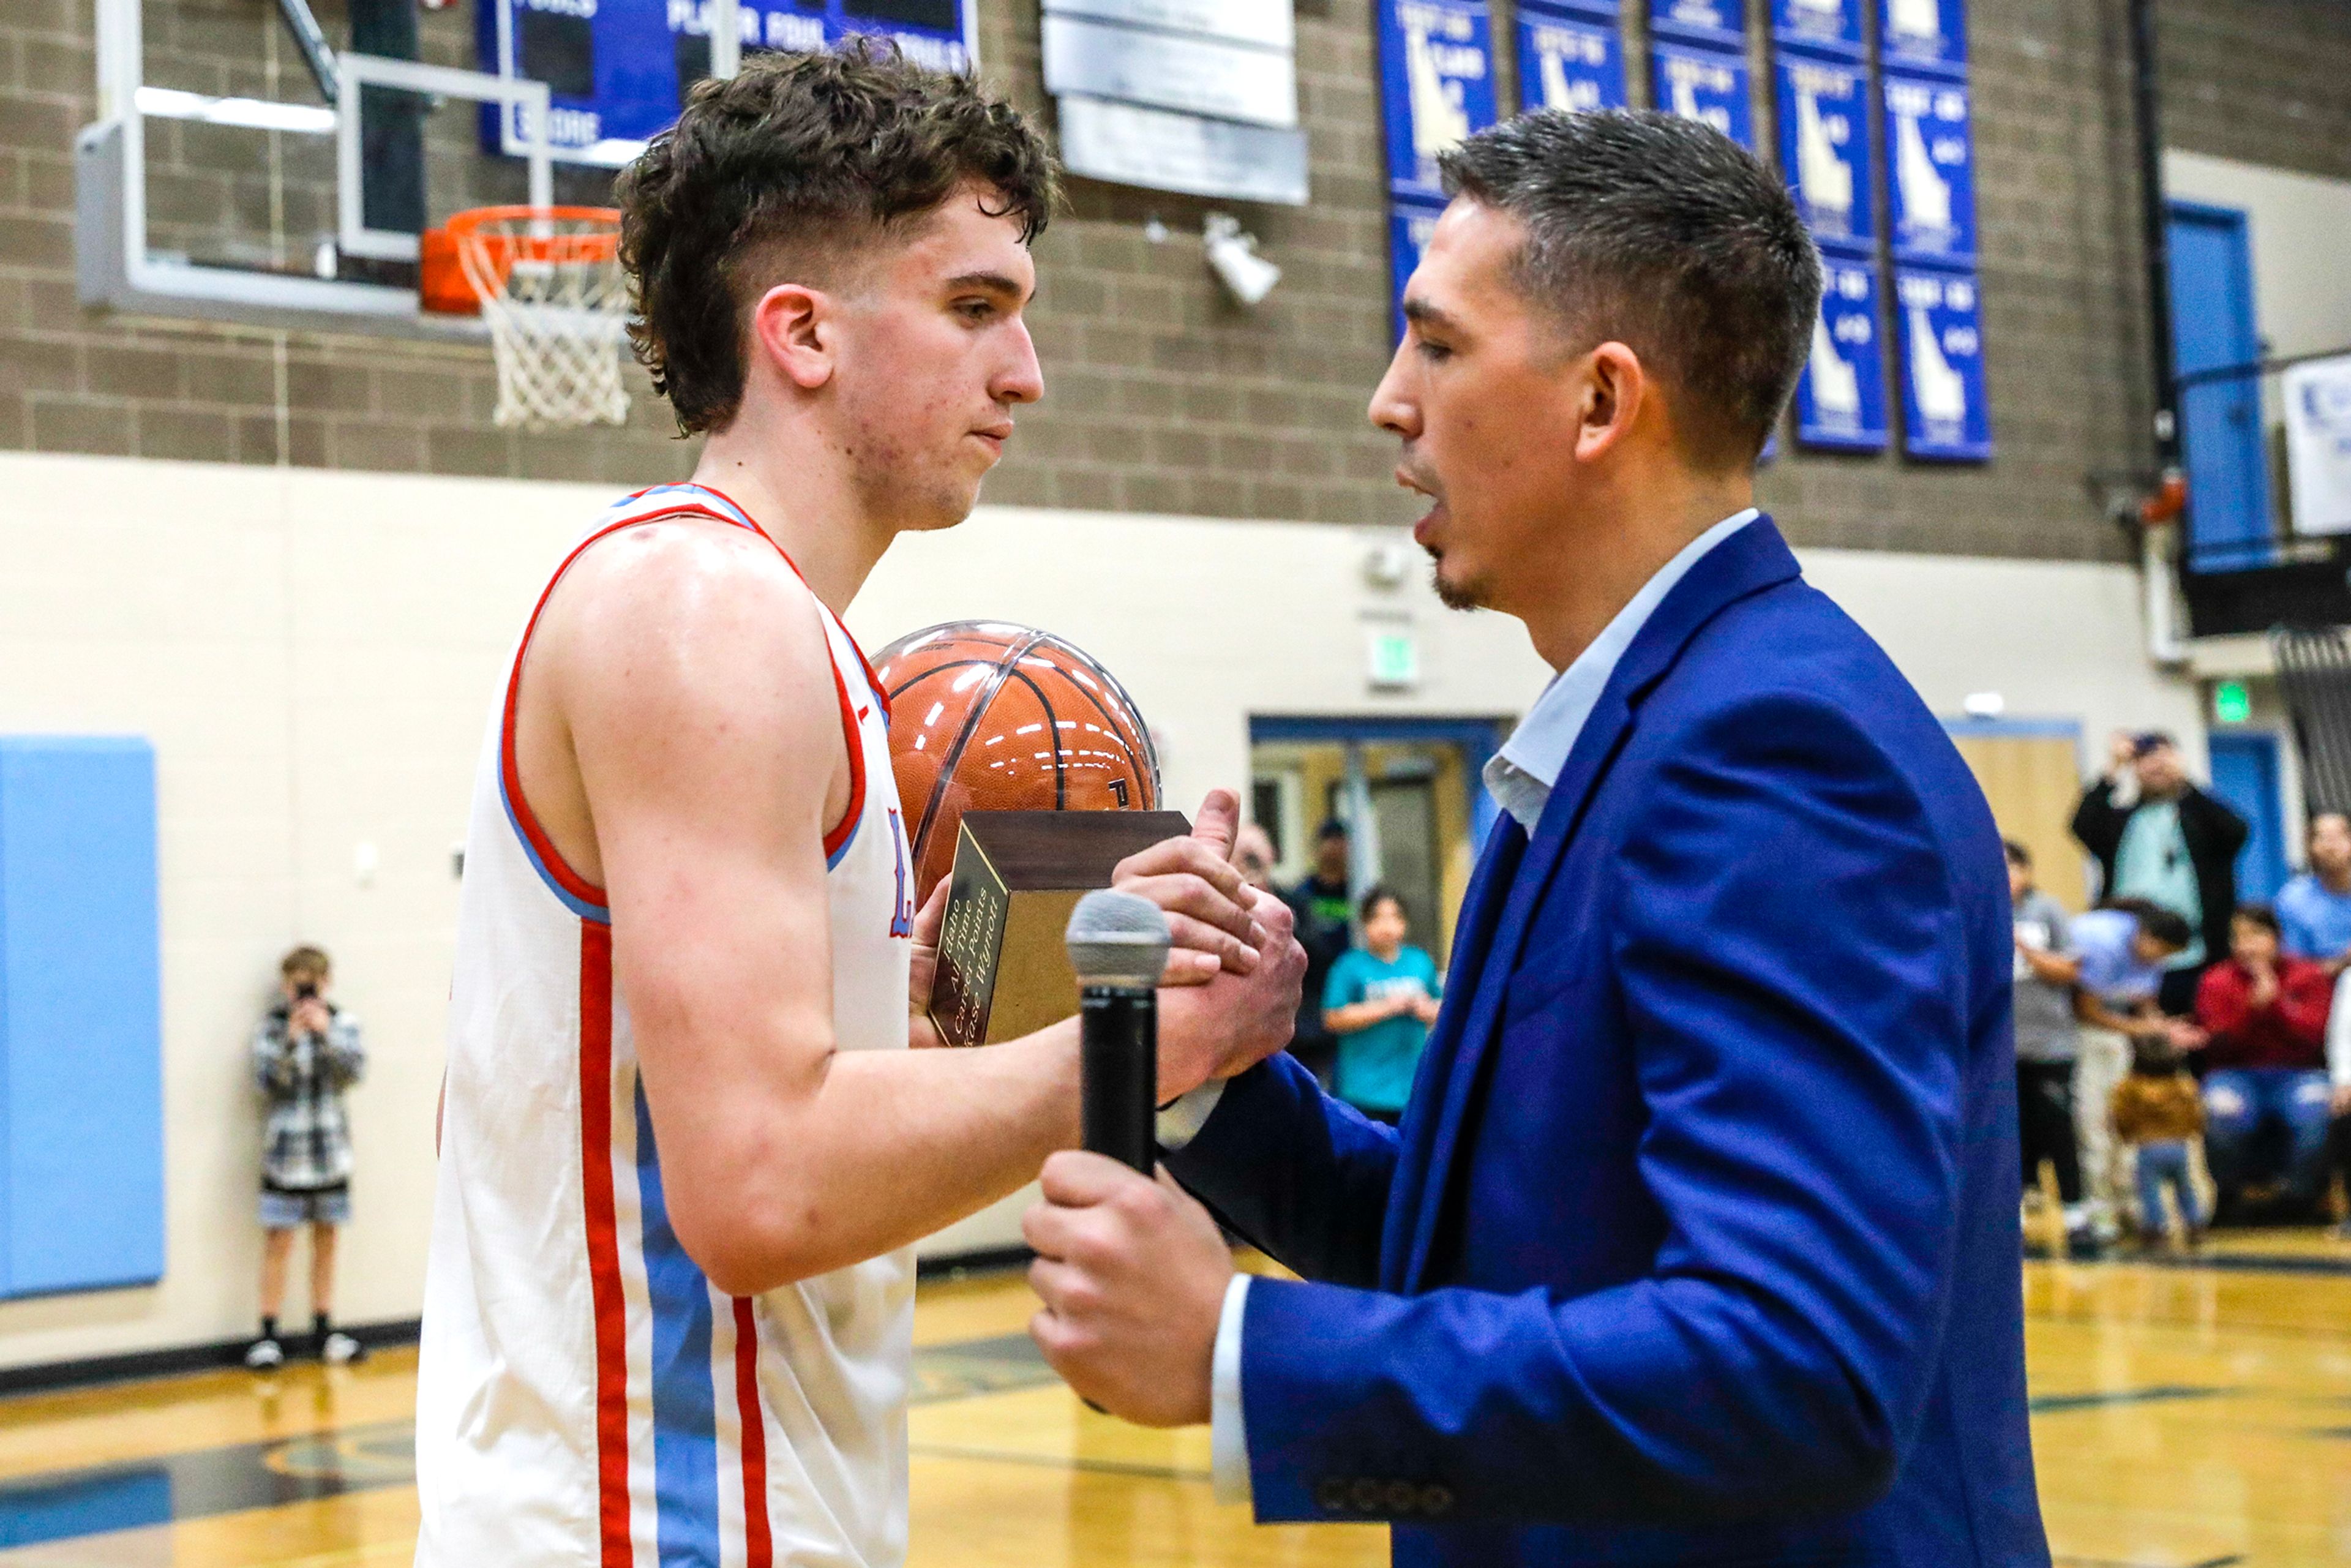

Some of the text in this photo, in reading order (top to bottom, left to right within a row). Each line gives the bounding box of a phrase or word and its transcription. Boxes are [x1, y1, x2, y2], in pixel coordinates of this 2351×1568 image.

[943, 899, 961, 962] Idaho
[950, 899, 972, 993] All-Time
[954, 887, 987, 1035] Career Points
[964, 896, 999, 1048] Kase Wynott
